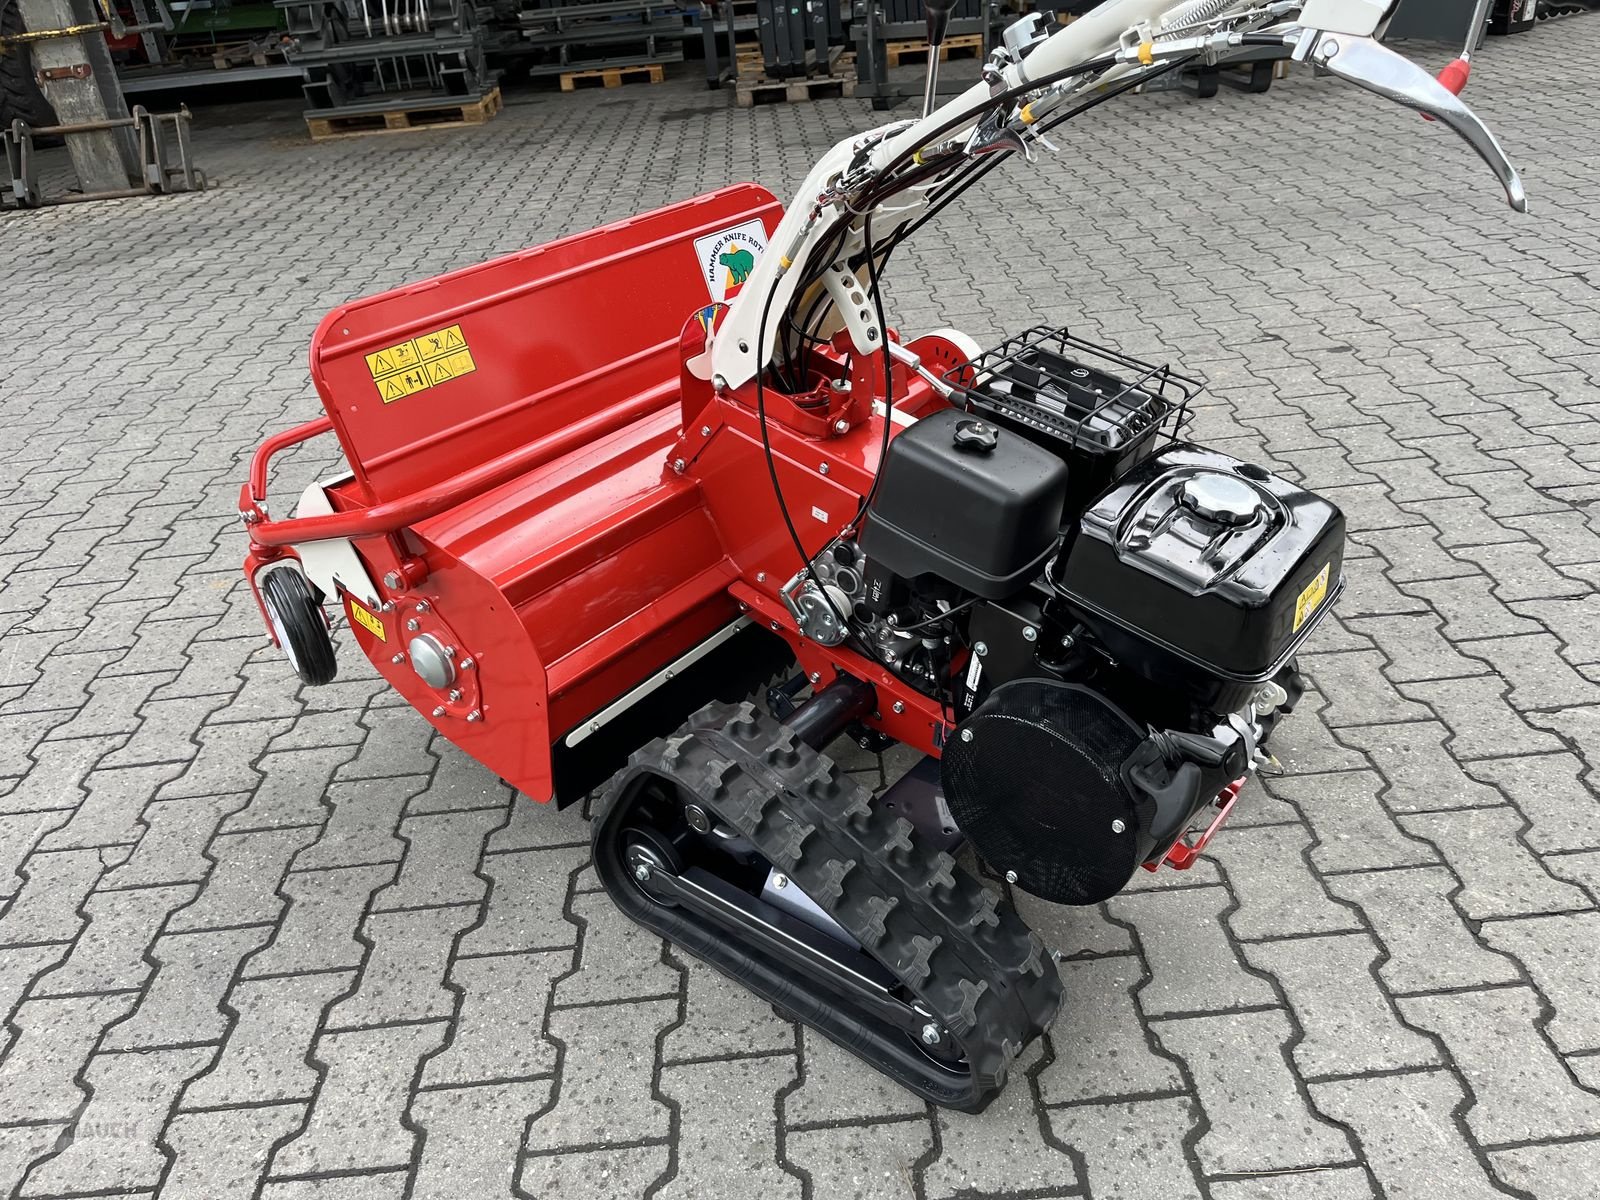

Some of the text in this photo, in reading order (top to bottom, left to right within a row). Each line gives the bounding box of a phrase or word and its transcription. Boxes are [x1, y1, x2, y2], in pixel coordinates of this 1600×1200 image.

[709, 232, 765, 282] HAMMER KNIFE ROT
